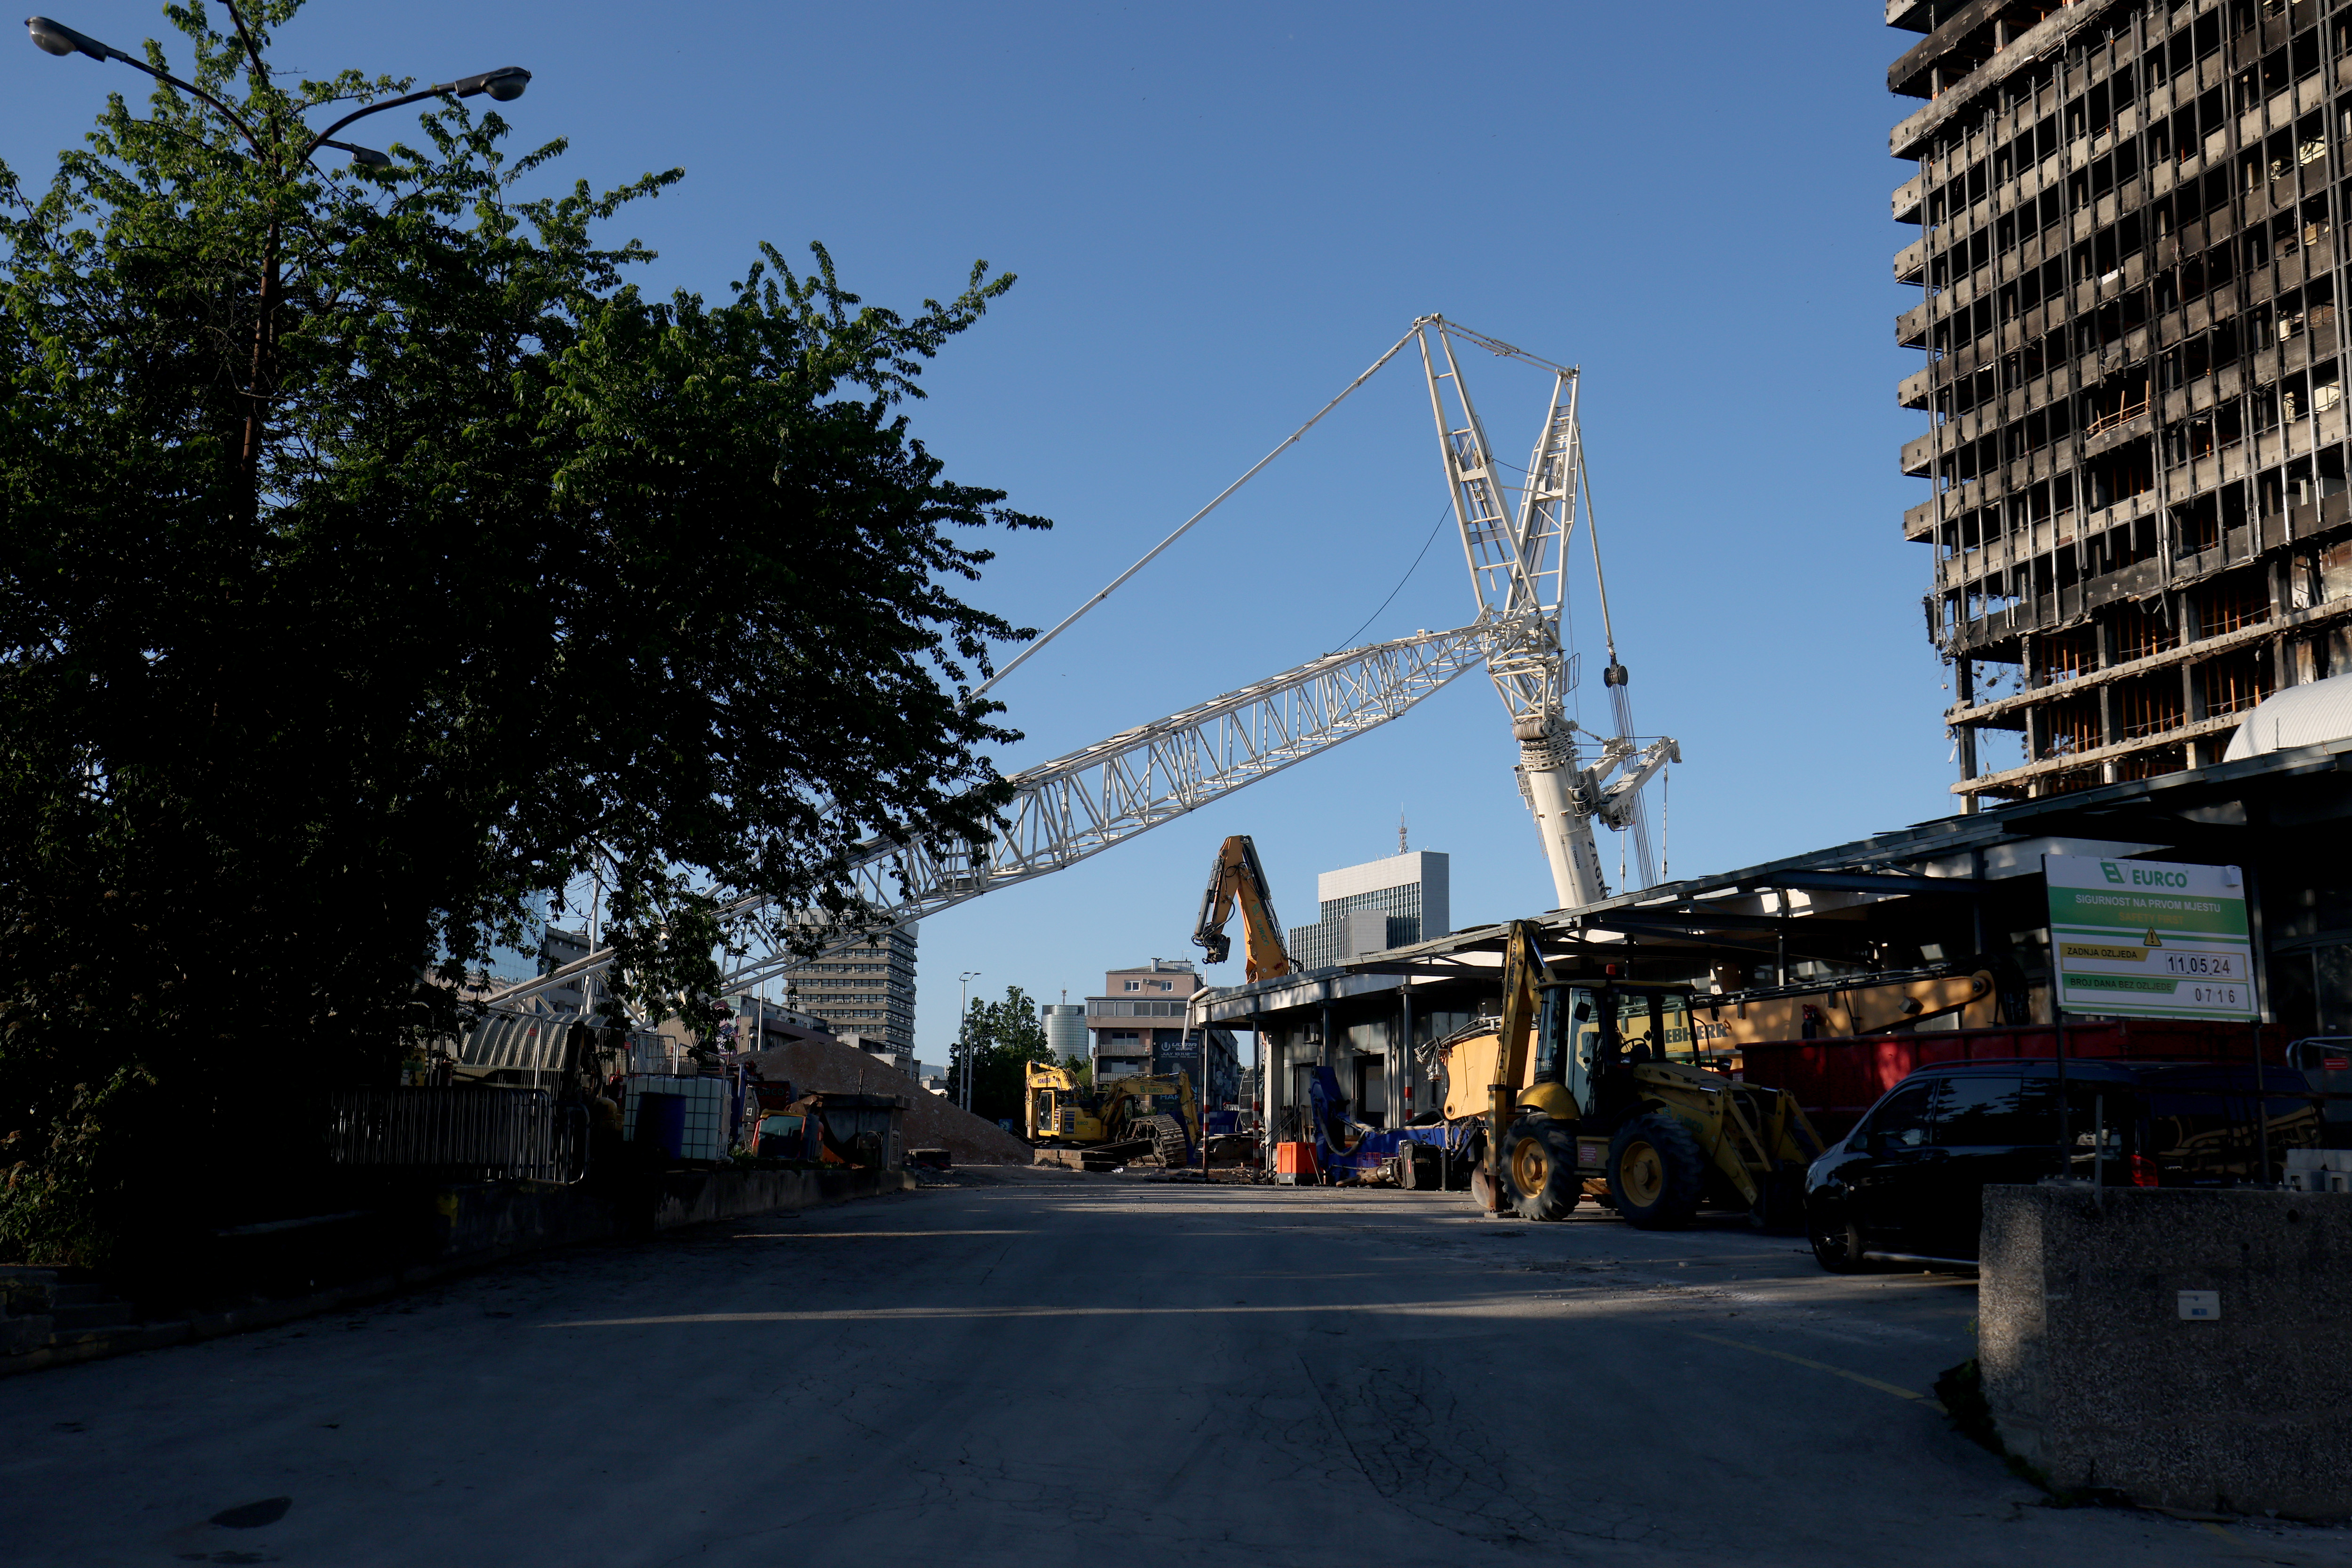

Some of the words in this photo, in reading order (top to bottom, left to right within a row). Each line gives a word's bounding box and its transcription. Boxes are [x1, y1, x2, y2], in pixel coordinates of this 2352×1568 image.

[2132, 869, 2187, 888] EURCO
[2075, 894, 2131, 907] SIGURNOST
[2133, 898, 2147, 907] NA
[2148, 899, 2182, 910] PRVOM
[2184, 902, 2221, 913] MJESTU
[2118, 912, 2155, 923] SAFETY
[2158, 915, 2184, 925] FIRST
[1255, 919, 1270, 947] EURCO
[2067, 947, 2099, 956] ZADNJA
[2101, 949, 2137, 959] OZLJEDA
[2168, 956, 2230, 975] 11.05.24
[2070, 978, 2092, 987] BROJ
[2094, 979, 2116, 988] DANA
[2137, 981, 2172, 991] OZLJEDE
